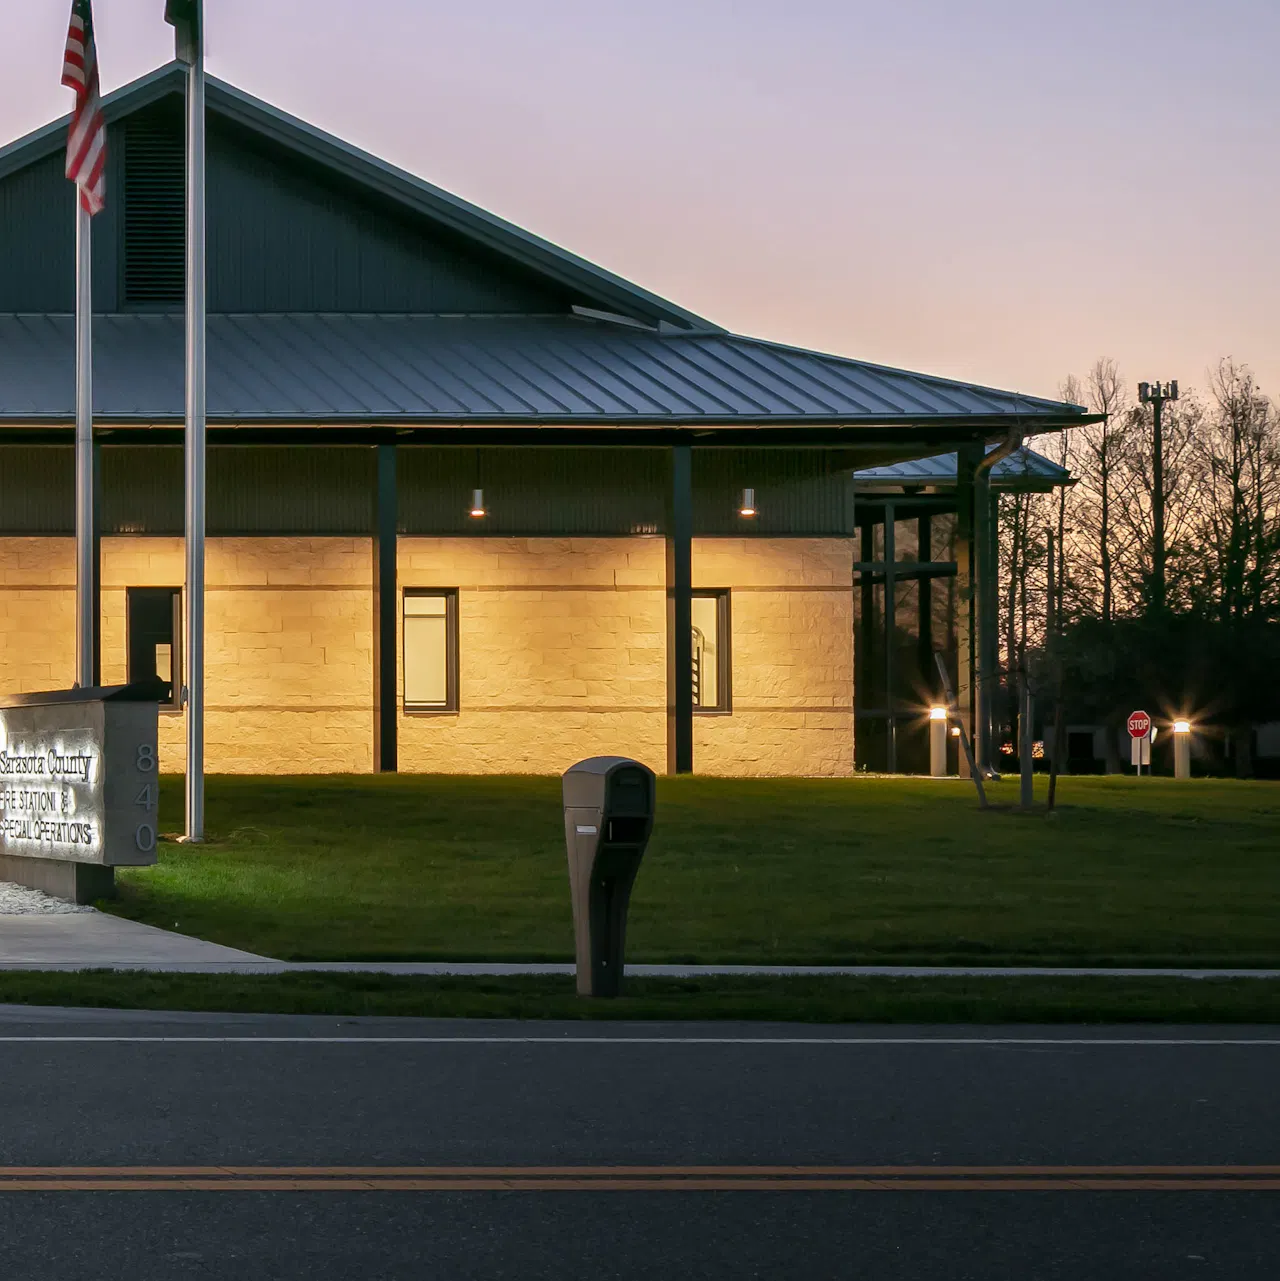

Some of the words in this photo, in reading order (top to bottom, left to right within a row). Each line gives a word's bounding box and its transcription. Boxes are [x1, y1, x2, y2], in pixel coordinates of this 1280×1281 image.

[1129, 719, 1149, 731] STOP
[0, 750, 46, 775] Sarasota
[47, 748, 93, 782] County
[0, 790, 16, 810] FIRE
[19, 790, 56, 812] STATION
[0, 819, 33, 840] SPECIAL
[33, 820, 93, 845] OPERATIONS
